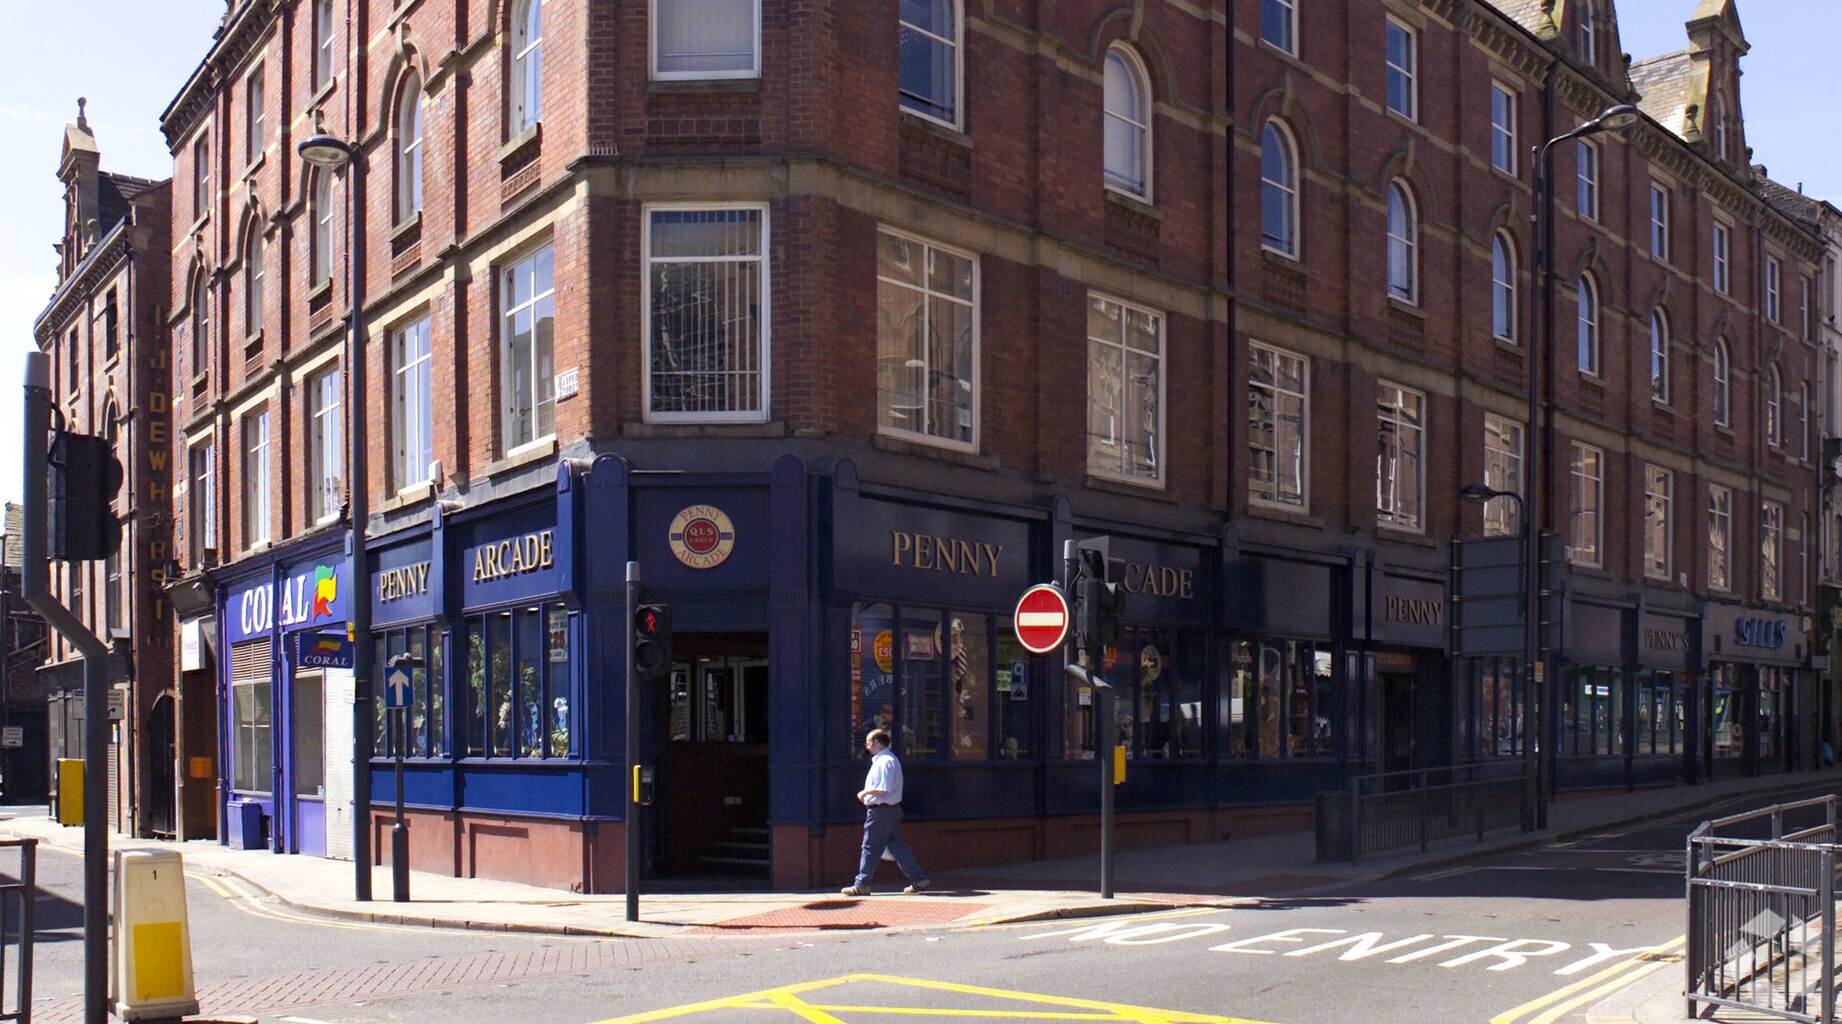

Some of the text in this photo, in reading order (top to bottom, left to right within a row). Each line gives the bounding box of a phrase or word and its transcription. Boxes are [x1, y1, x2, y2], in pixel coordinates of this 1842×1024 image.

[680, 506, 720, 522] PENNY
[689, 527, 714, 537] QLS
[379, 530, 555, 602] PENNY ARCADE
[678, 547, 727, 566] ARCADE
[890, 530, 1194, 599] PENNY CADE
[241, 574, 310, 635] COAL
[1385, 596, 1443, 627] PENNY
[304, 655, 349, 667] CORAL
[152, 869, 157, 881] 1
[1018, 921, 1661, 976] NO ENTRY
